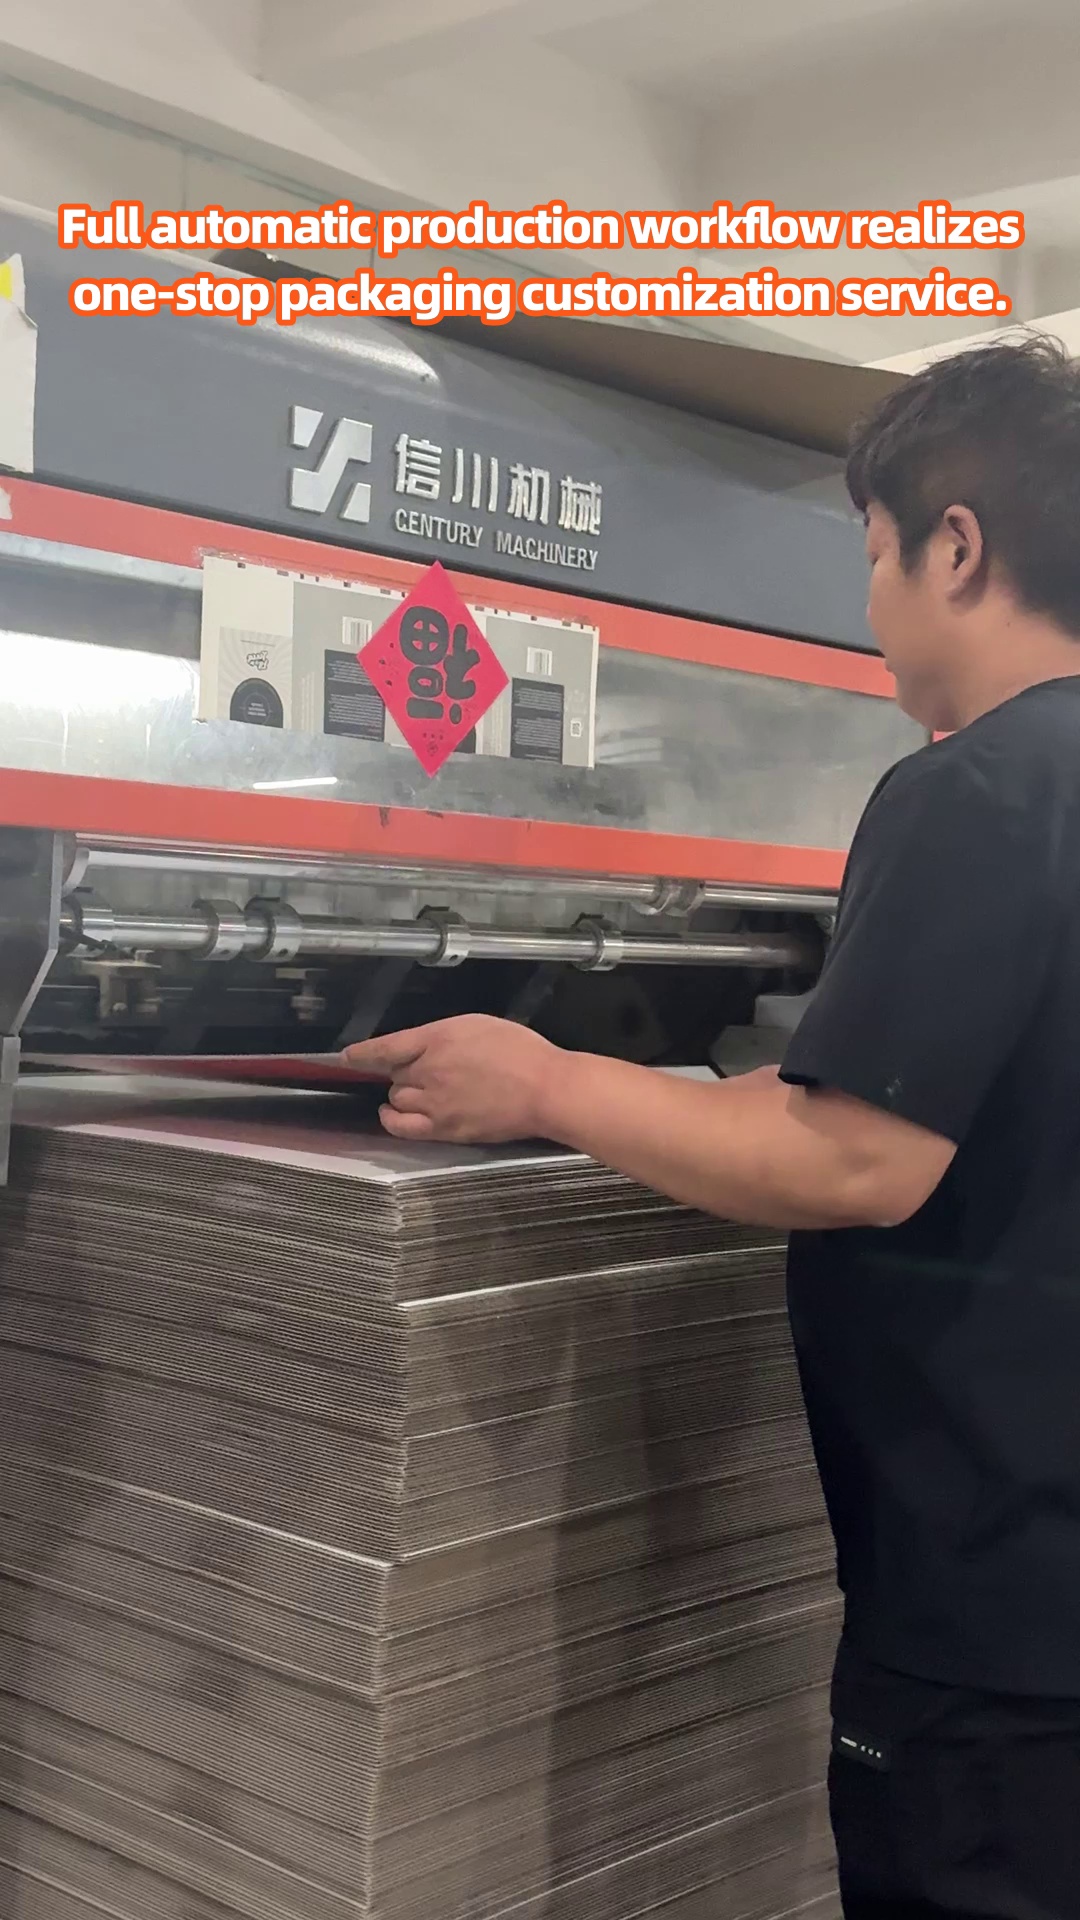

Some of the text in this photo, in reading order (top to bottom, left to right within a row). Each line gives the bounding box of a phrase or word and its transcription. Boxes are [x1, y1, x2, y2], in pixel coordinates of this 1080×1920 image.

[395, 433, 603, 536] 信川机械
[394, 508, 599, 571] CENTURY MACHINERY
[399, 605, 481, 725] 福
